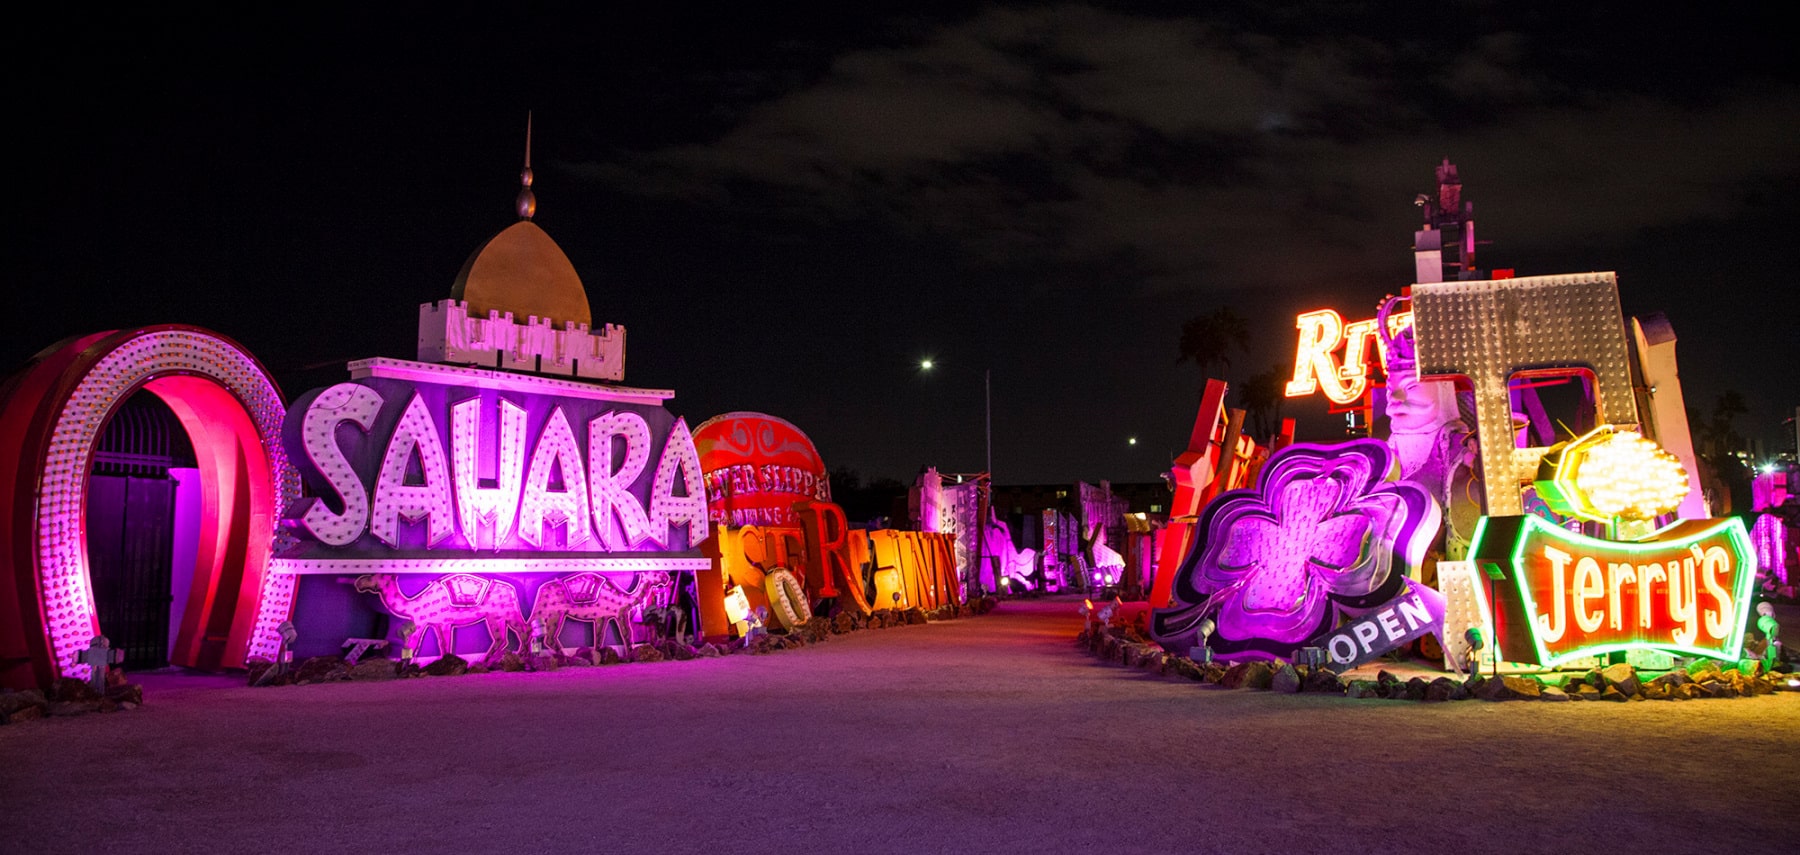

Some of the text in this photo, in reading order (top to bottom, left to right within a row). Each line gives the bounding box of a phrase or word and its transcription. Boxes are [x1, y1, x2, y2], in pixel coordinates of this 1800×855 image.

[302, 382, 709, 553] SAHARA
[1328, 595, 1433, 665] OPEN
[1537, 542, 1732, 647] Jerry's
